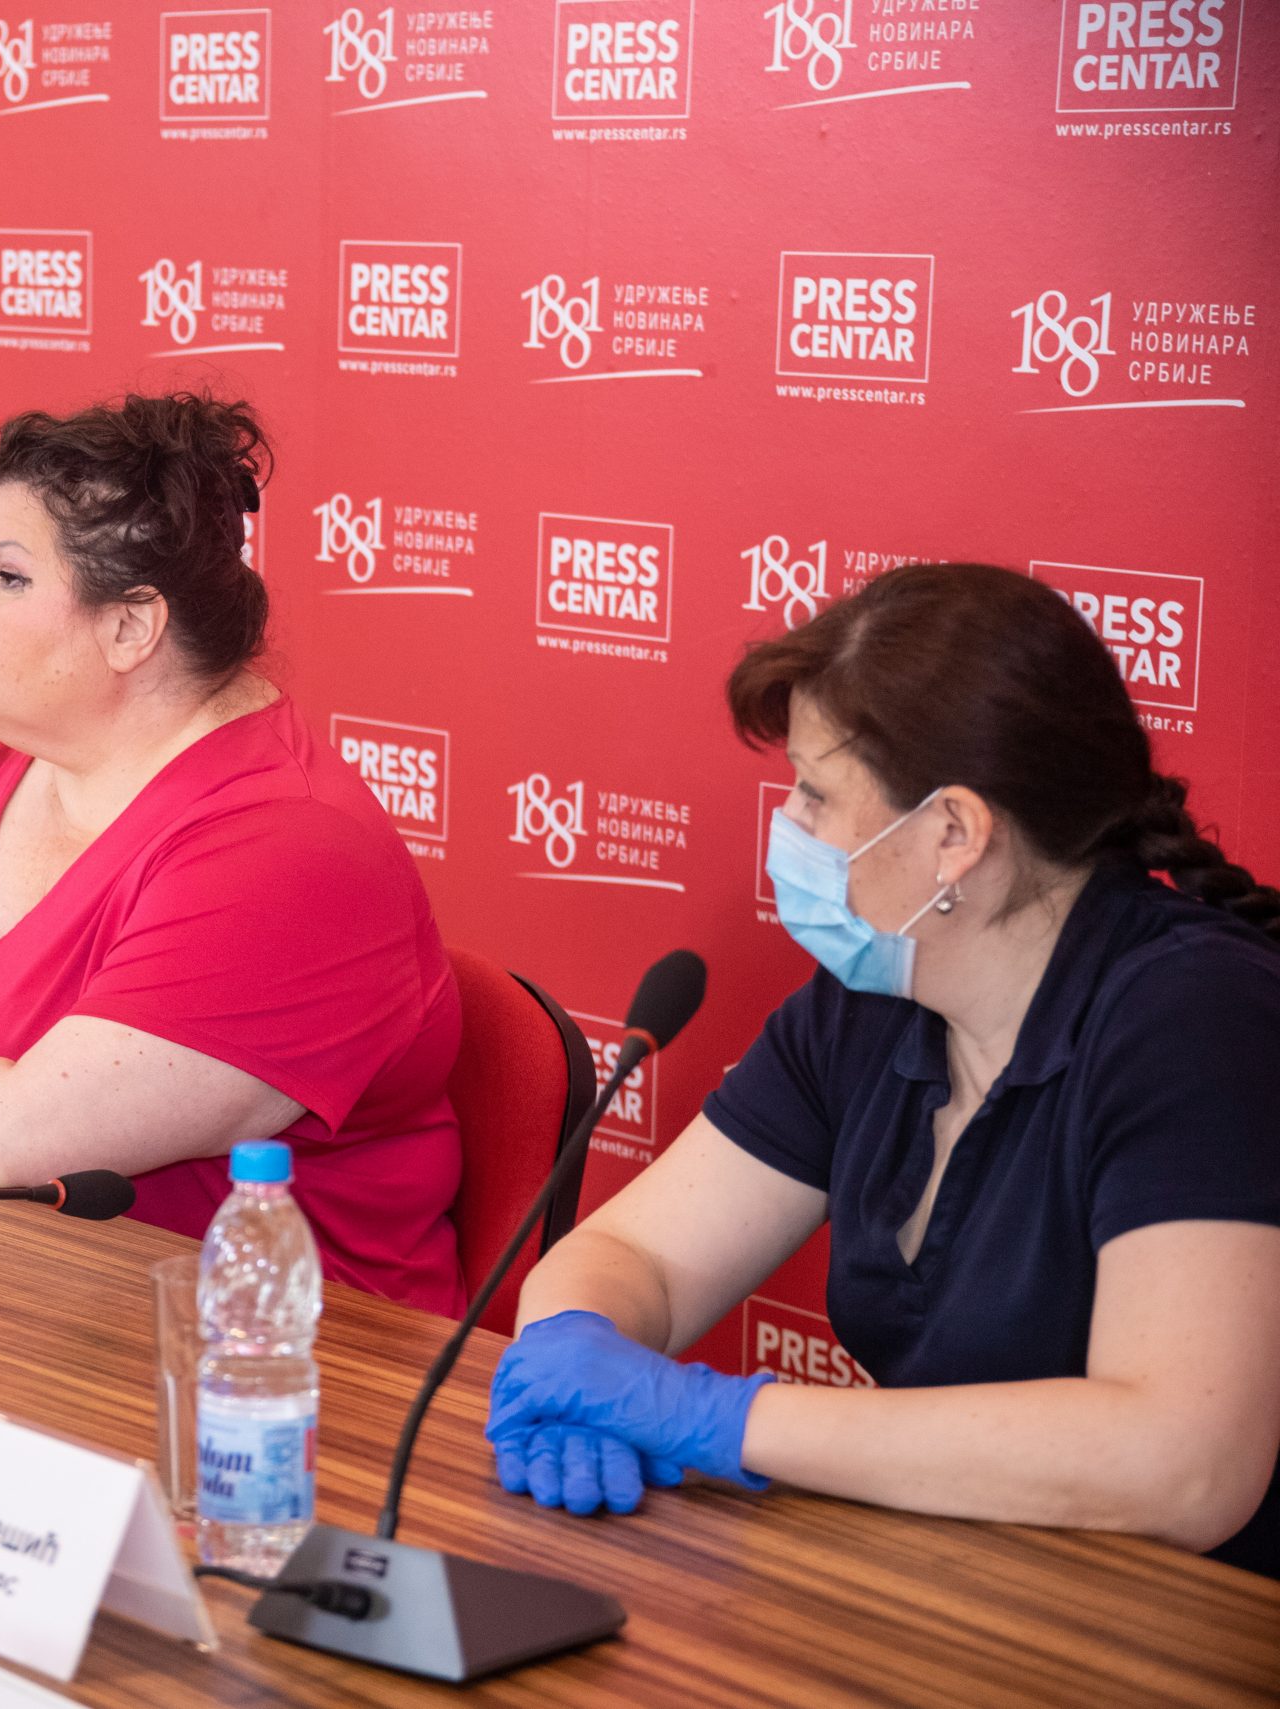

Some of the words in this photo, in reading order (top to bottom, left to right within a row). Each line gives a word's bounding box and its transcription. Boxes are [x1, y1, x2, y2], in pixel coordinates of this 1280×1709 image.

[406, 11, 493, 32] УДРУЖЕЊЕ
[869, 20, 975, 43] НОВИНАРА
[1077, 0, 1224, 50] PRESS
[170, 31, 260, 71] PRESS
[323, 8, 397, 98] 1881
[406, 37, 489, 57] НОВИНАРА
[567, 20, 679, 65] PRESS
[405, 62, 464, 82] СРБИЈЕ
[868, 50, 942, 72] СРБИЈЕ
[1072, 52, 1221, 92] CENTAR
[169, 73, 259, 105] CENTAR
[564, 67, 677, 102] CENTAR
[552, 126, 687, 142] www.presscentar.rs
[1056, 119, 1232, 138] www.presscentar.rs
[1, 249, 82, 286] PRESS
[350, 263, 449, 306] PRESS
[614, 285, 709, 307] УДРУЖЕЊЕ
[1, 288, 82, 319] CENTAR
[138, 259, 206, 343] 1881
[792, 277, 917, 325] PRESS
[1132, 302, 1256, 328] УДРУЖЕЊЕ
[348, 306, 448, 340] CENTAR
[521, 275, 603, 368] 1881
[613, 310, 705, 332] НОВИНАРА
[612, 336, 677, 358] СРБИЈЕ
[790, 324, 914, 363] CENTAR
[1011, 290, 1116, 397] 1881
[1131, 331, 1250, 357] НОВИНАРА
[338, 359, 458, 378] www.presscentar.rs
[1128, 361, 1212, 386] СРБИЈЕ
[776, 384, 926, 406] www.presscentar.rs
[394, 506, 479, 531] УДРУЖЕЊЕ
[313, 493, 386, 583] 1881
[393, 531, 475, 555] НОВИНАРА
[393, 554, 450, 577] СРБИЈЕ
[550, 536, 660, 588] PRESS
[844, 550, 949, 574] УДРУЖ
[740, 535, 831, 631] 1881
[548, 582, 658, 625] CENTAR
[1052, 589, 1184, 648] RESS
[536, 633, 669, 662] www.presscentar.rs
[1106, 645, 1181, 688] TAR
[366, 780, 436, 823] NTAR
[598, 792, 690, 824] УДРУЖЕЊЕ
[507, 773, 588, 868] 1881
[597, 816, 687, 848] НОВИНАРА
[596, 842, 660, 870] СРБИЈЕ
